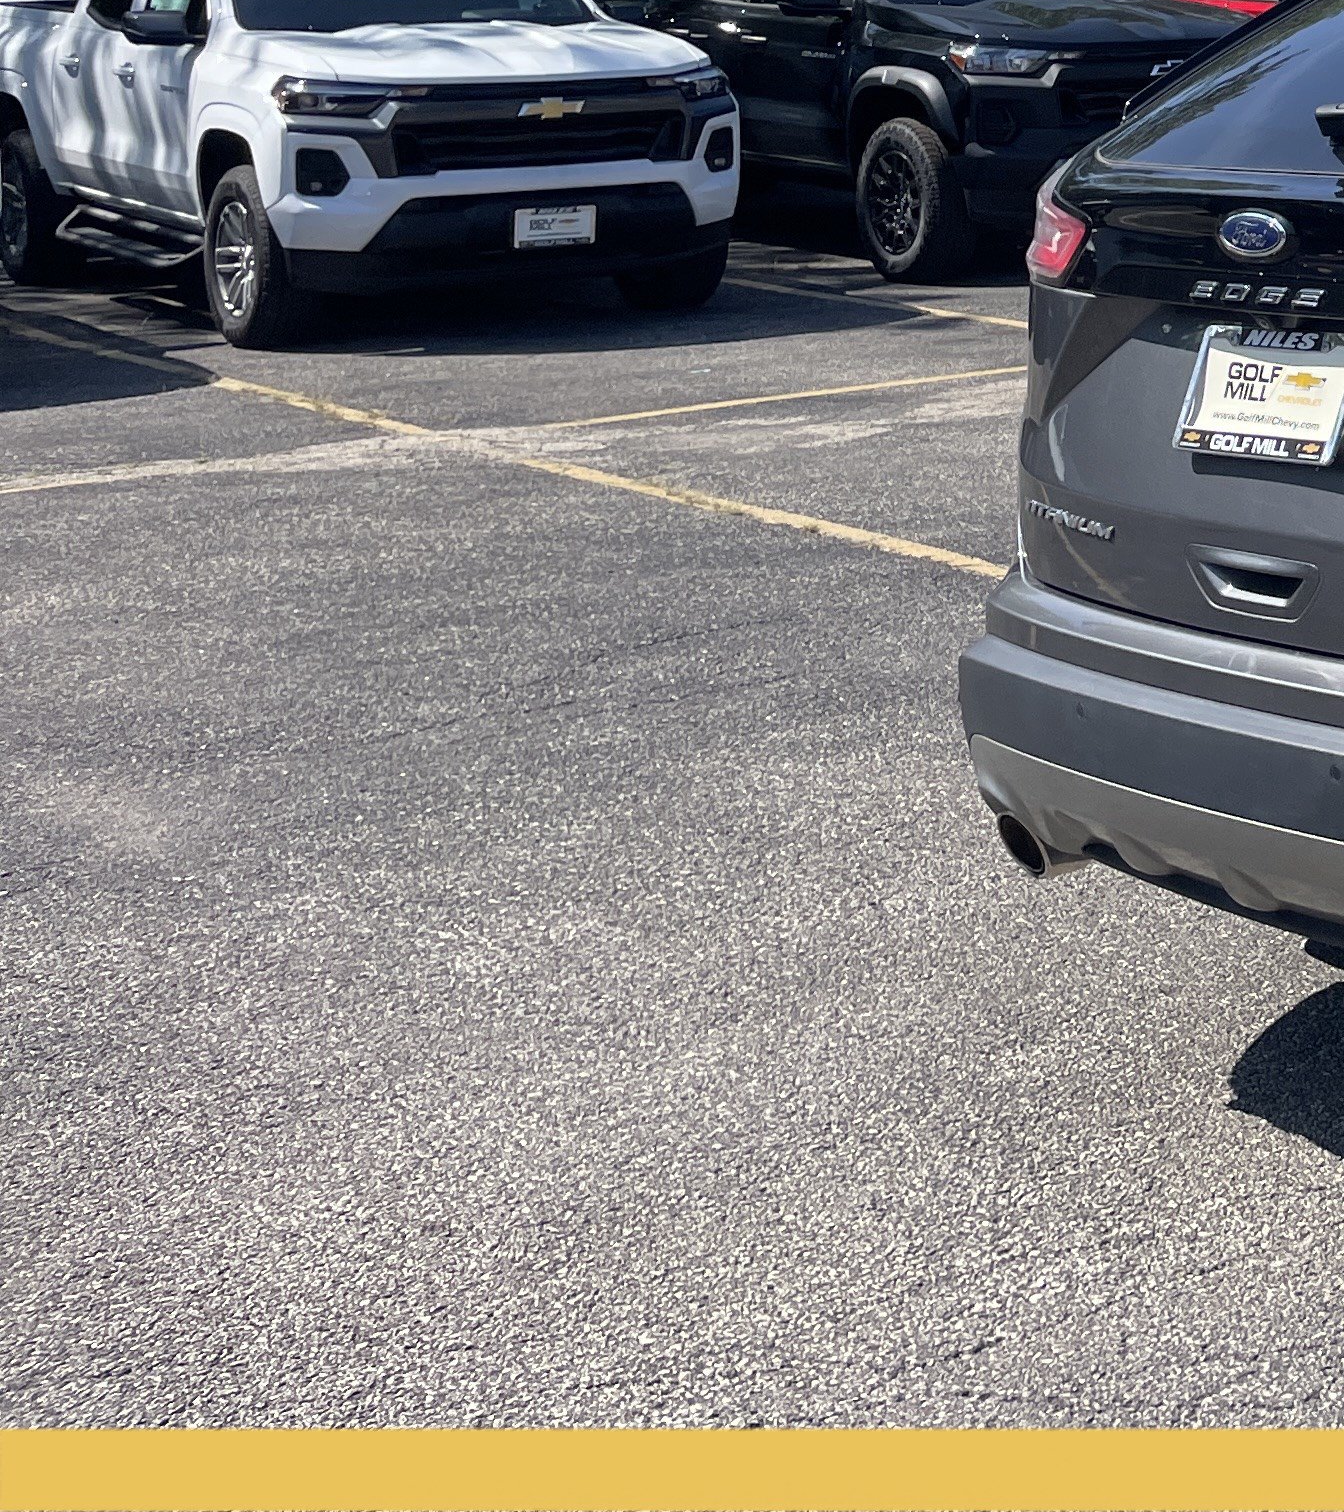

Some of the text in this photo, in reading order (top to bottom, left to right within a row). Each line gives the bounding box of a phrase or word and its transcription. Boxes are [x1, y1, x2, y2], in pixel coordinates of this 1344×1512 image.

[1231, 221, 1269, 248] Ford
[1189, 280, 1326, 308] EDGE
[1243, 329, 1320, 350] NILES
[1228, 361, 1283, 384] GOLF
[1223, 380, 1267, 402] MILL
[1209, 433, 1290, 457] GOLF MILL
